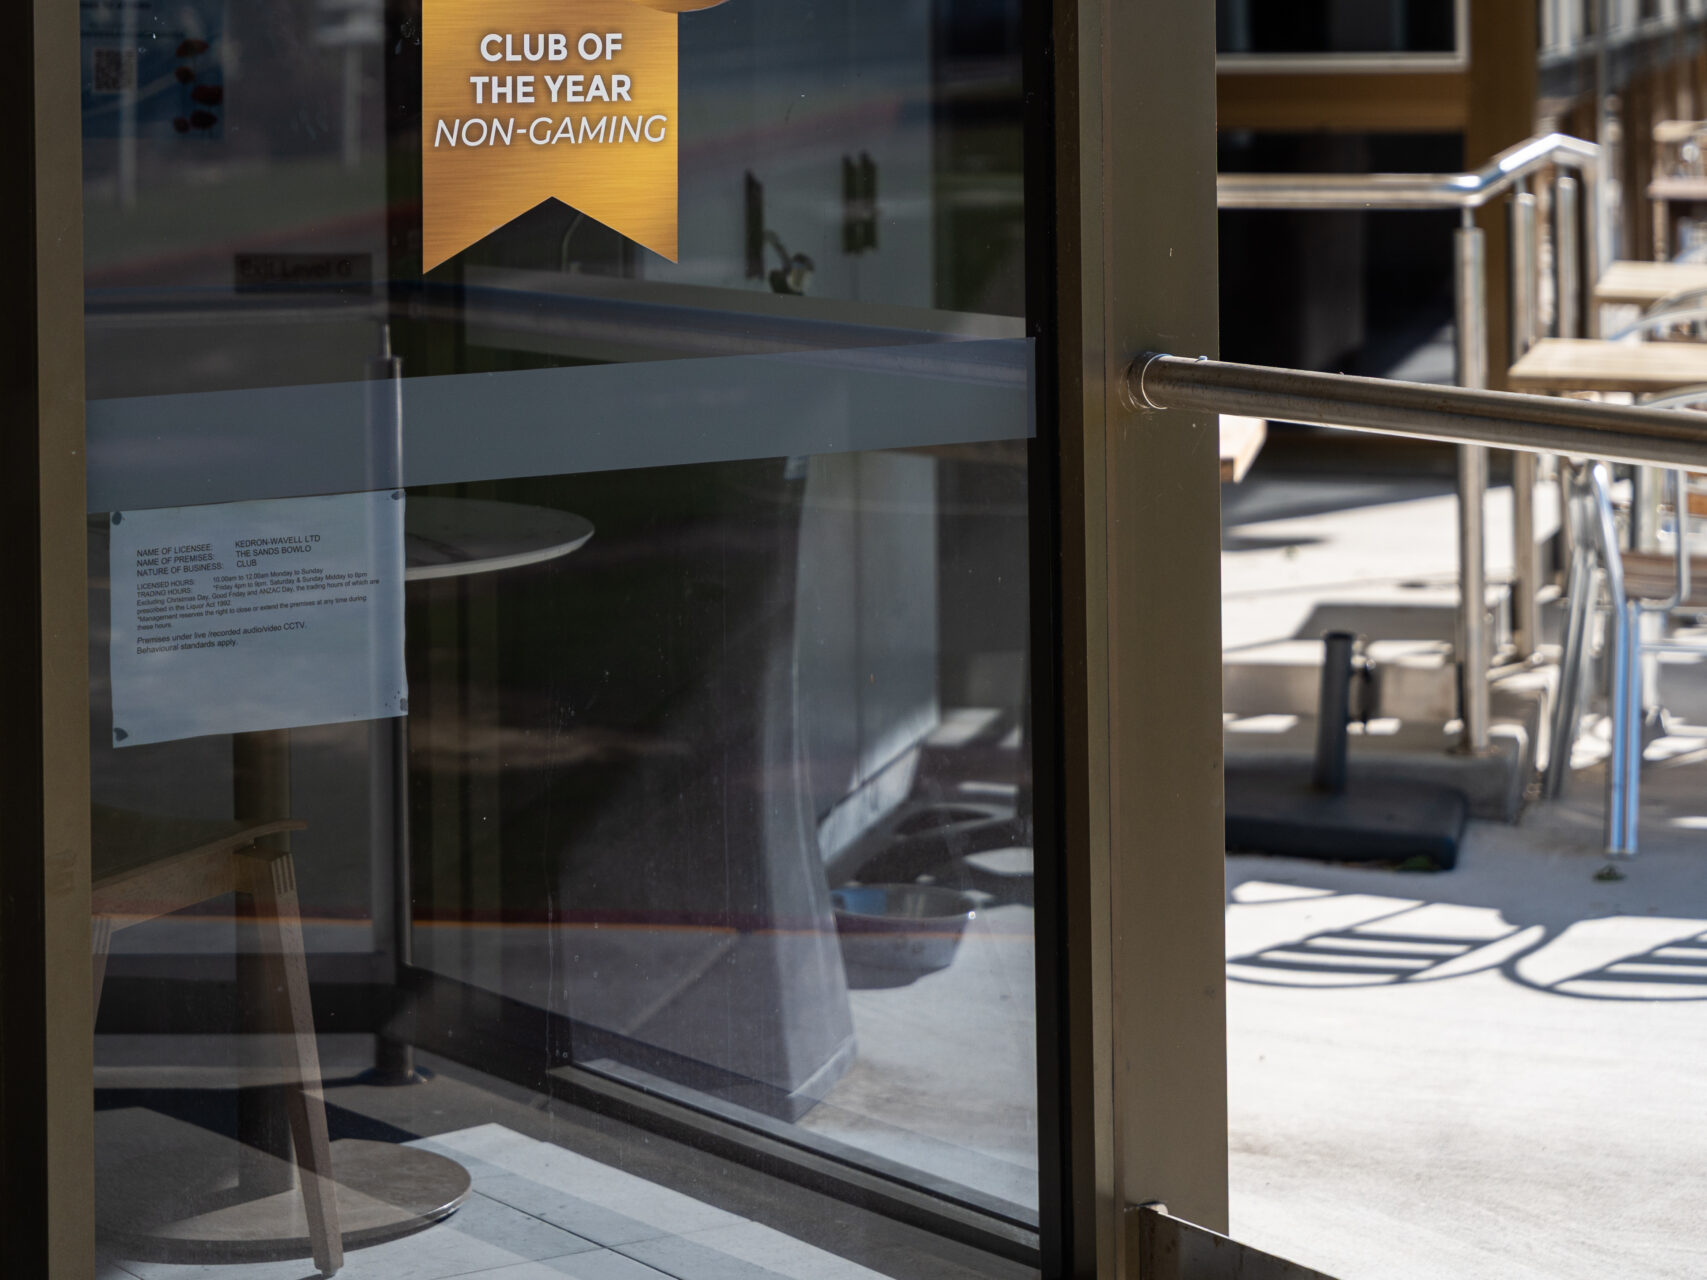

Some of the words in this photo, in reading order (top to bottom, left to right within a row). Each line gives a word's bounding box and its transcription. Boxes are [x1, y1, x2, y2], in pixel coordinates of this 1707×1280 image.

[480, 33, 568, 62] CLUB
[577, 33, 622, 61] OF
[470, 75, 535, 104] THE
[544, 74, 632, 103] YEAR
[434, 114, 667, 147] NON-GAMING
[235, 536, 303, 548] KEDRON-WAVELL
[305, 535, 320, 543] LTD
[137, 548, 159, 557] NAME
[175, 543, 213, 554] LICENSEE:
[236, 550, 252, 558] THE
[253, 547, 280, 556] SANDS
[282, 544, 312, 554] BOWLO
[137, 558, 159, 567] NAME
[174, 553, 214, 563] PREMISES:
[236, 559, 257, 568] CLUB
[137, 567, 168, 576] NATURE
[184, 562, 224, 572] BUSINESS:
[271, 569, 293, 577] Monday
[137, 580, 169, 590] LICENSED
[270, 578, 294, 586] Saturday
[303, 575, 323, 583] Sunday
[326, 573, 346, 581] Midday
[137, 590, 166, 598] TRADING
[137, 598, 165, 606] Excluding
[167, 595, 195, 603] Christmas
[260, 586, 280, 594] ANZAC
[296, 584, 305, 592] the
[307, 582, 325, 590] trading
[137, 606, 167, 615] prescribed
[216, 607, 228, 615] right
[260, 602, 279, 610] extend
[290, 600, 315, 608] premises
[349, 594, 367, 602] during
[137, 634, 170, 644] Premises
[172, 632, 192, 641] under
[242, 624, 282, 634] audio/video
[137, 644, 179, 654] Behavioural
[181, 640, 215, 650] standards
